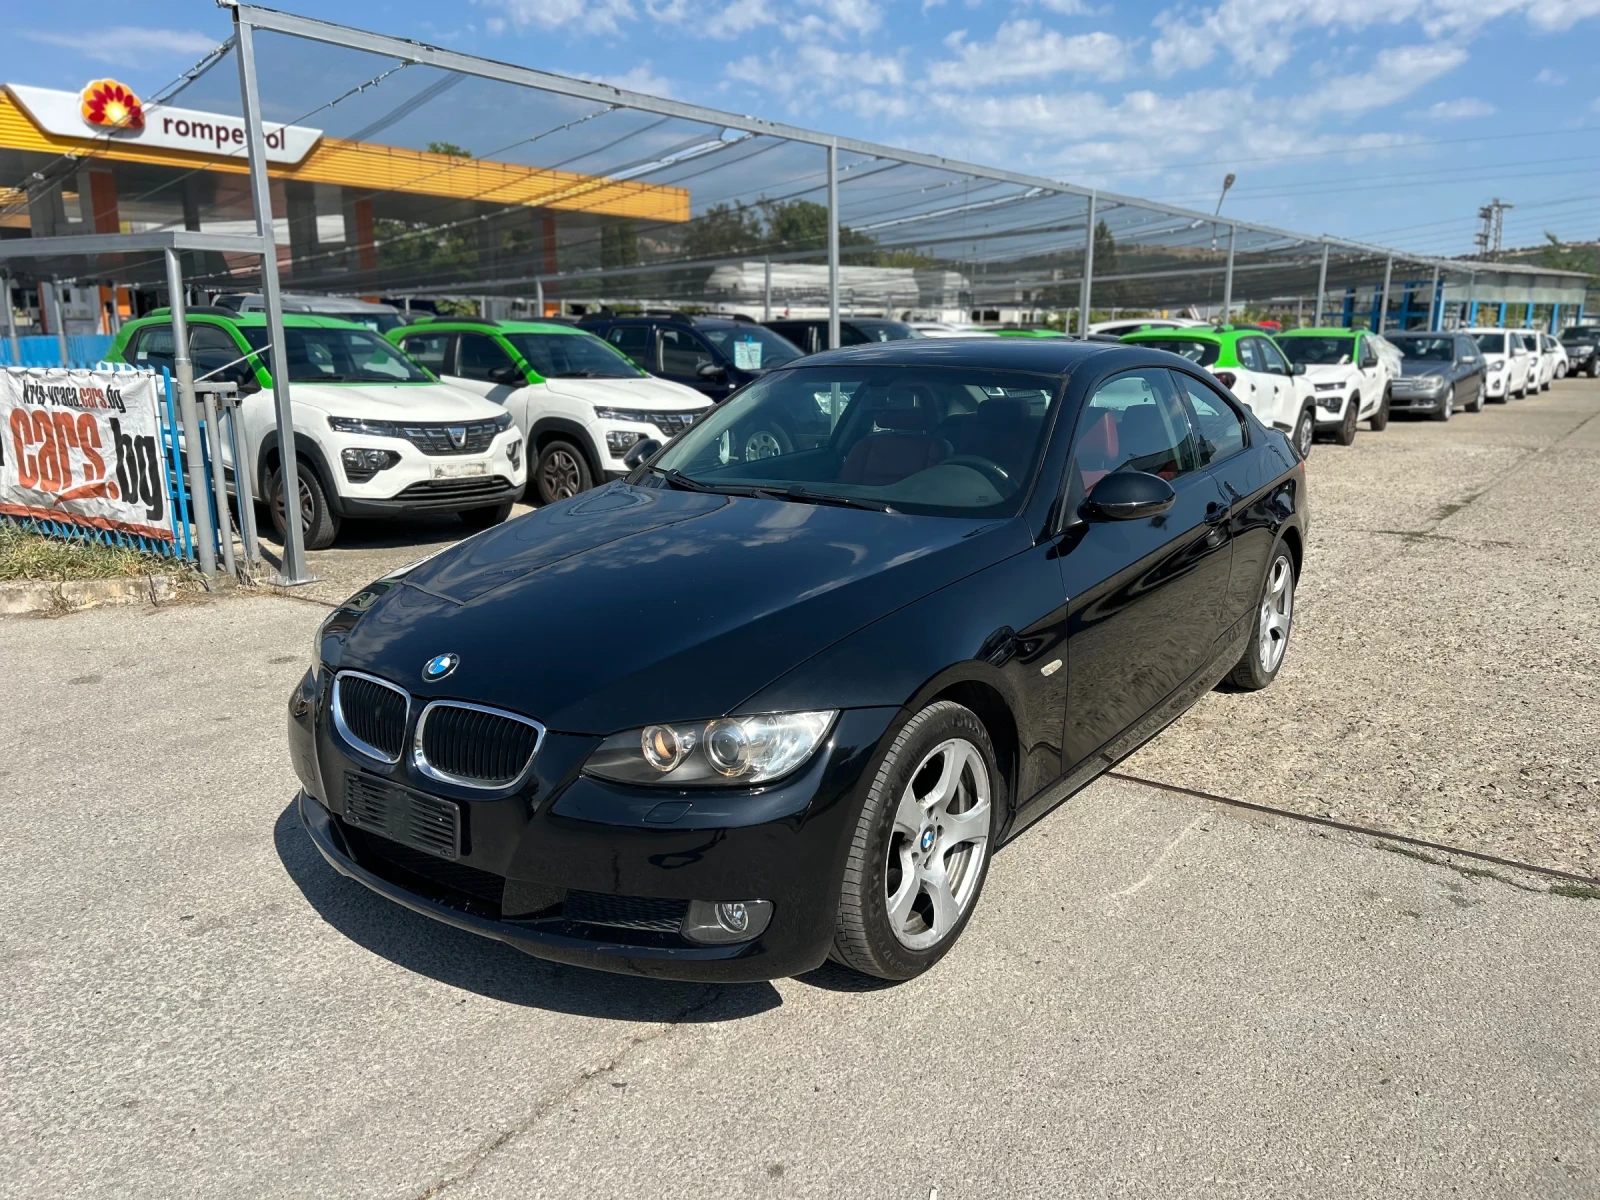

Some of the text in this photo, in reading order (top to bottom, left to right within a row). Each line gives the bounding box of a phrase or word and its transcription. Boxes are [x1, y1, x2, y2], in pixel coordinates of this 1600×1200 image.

[163, 116, 286, 151] rompeol
[22, 379, 127, 414] kris-vraca.cars.bg
[9, 408, 164, 521] cars.bg
